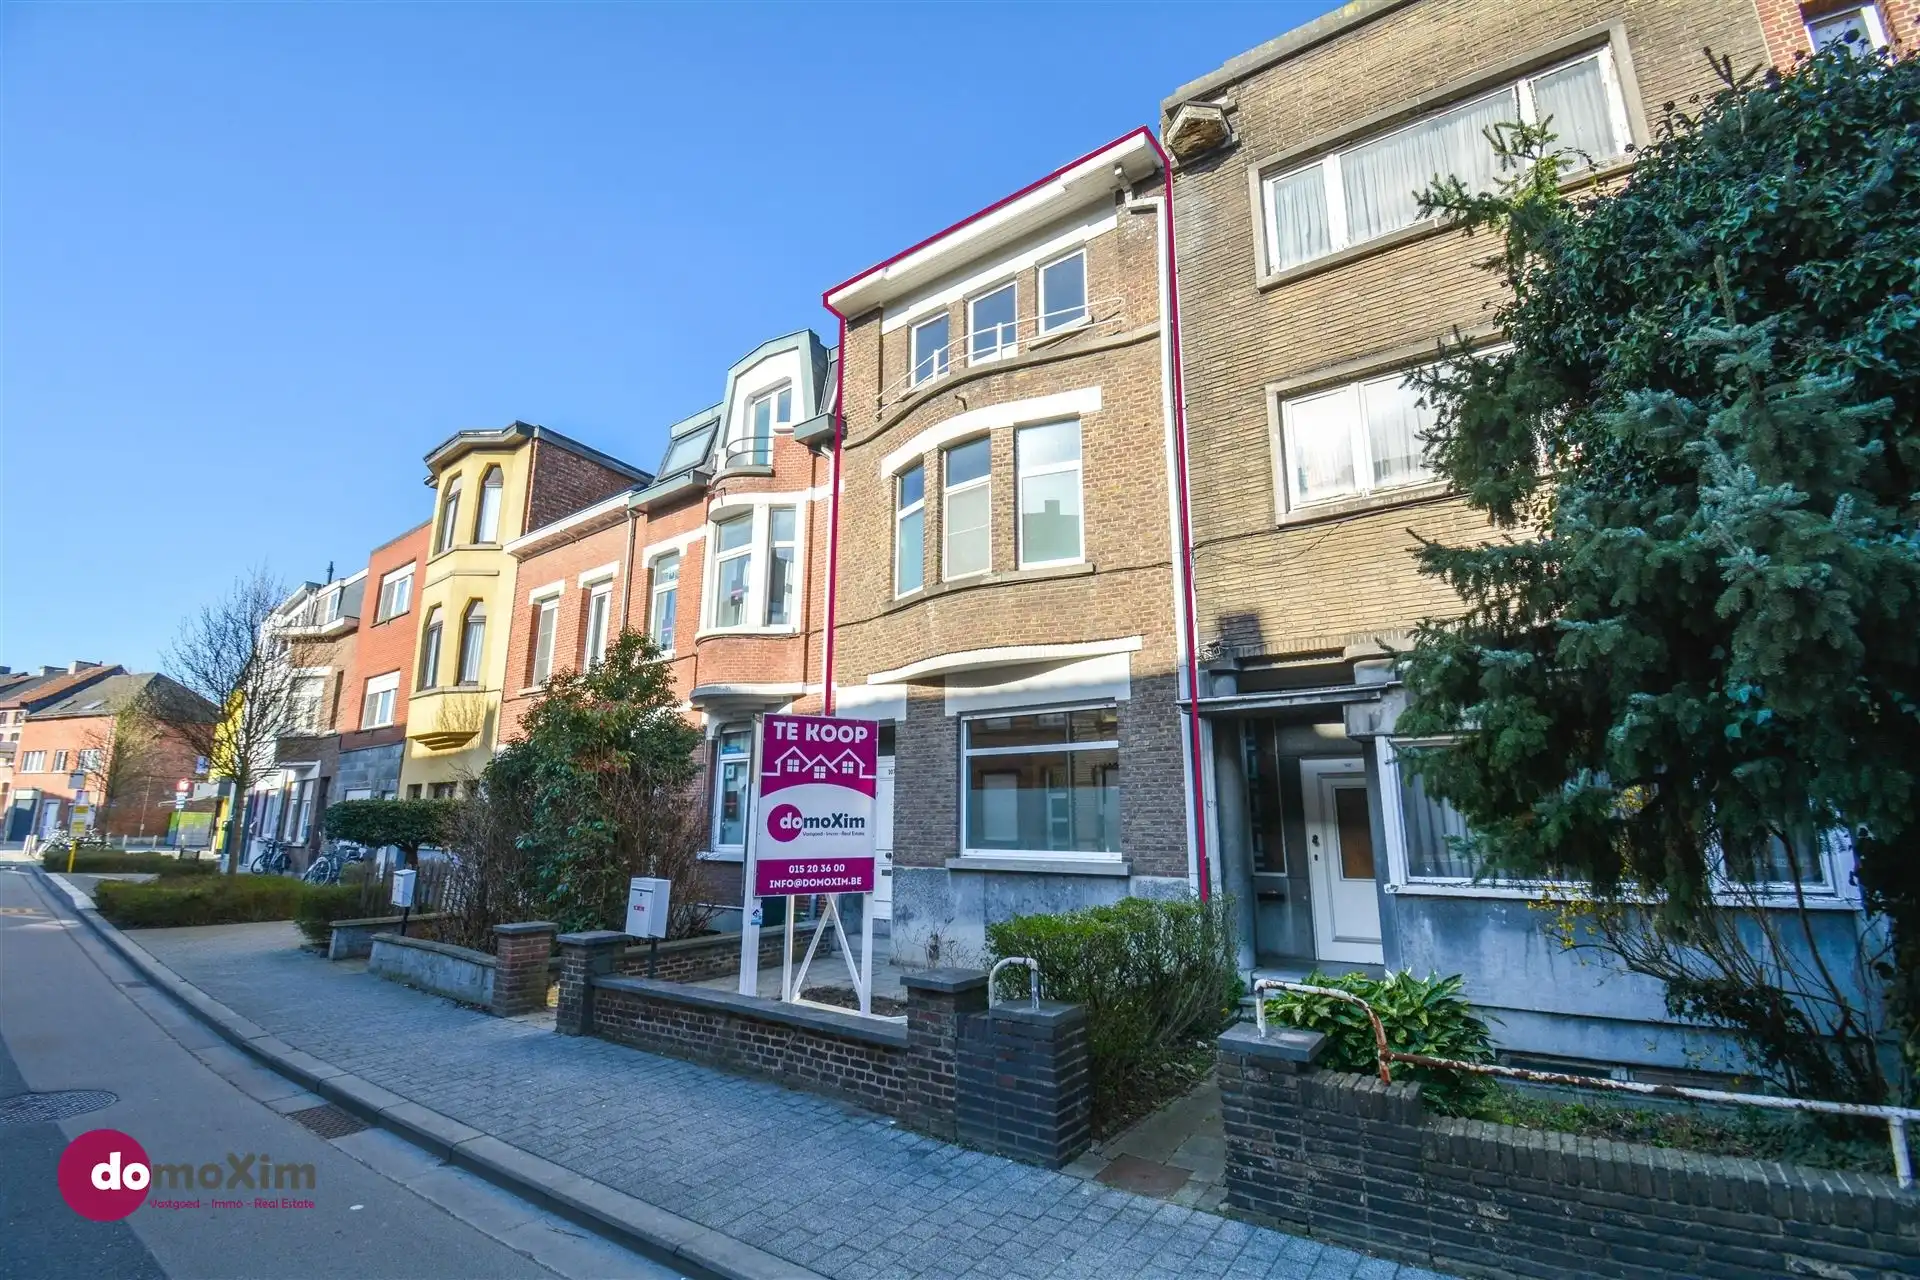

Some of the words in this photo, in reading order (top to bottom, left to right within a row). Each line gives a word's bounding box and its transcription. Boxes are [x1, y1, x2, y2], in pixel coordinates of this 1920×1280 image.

[773, 721, 799, 741] TE
[805, 723, 868, 744] KOOP
[779, 812, 865, 829] domoXim
[788, 864, 805, 874] 015
[806, 864, 818, 873] 20
[820, 864, 831, 873] 36
[833, 863, 845, 872] 00
[769, 876, 862, 889] INFO@DOMOXIM.BE
